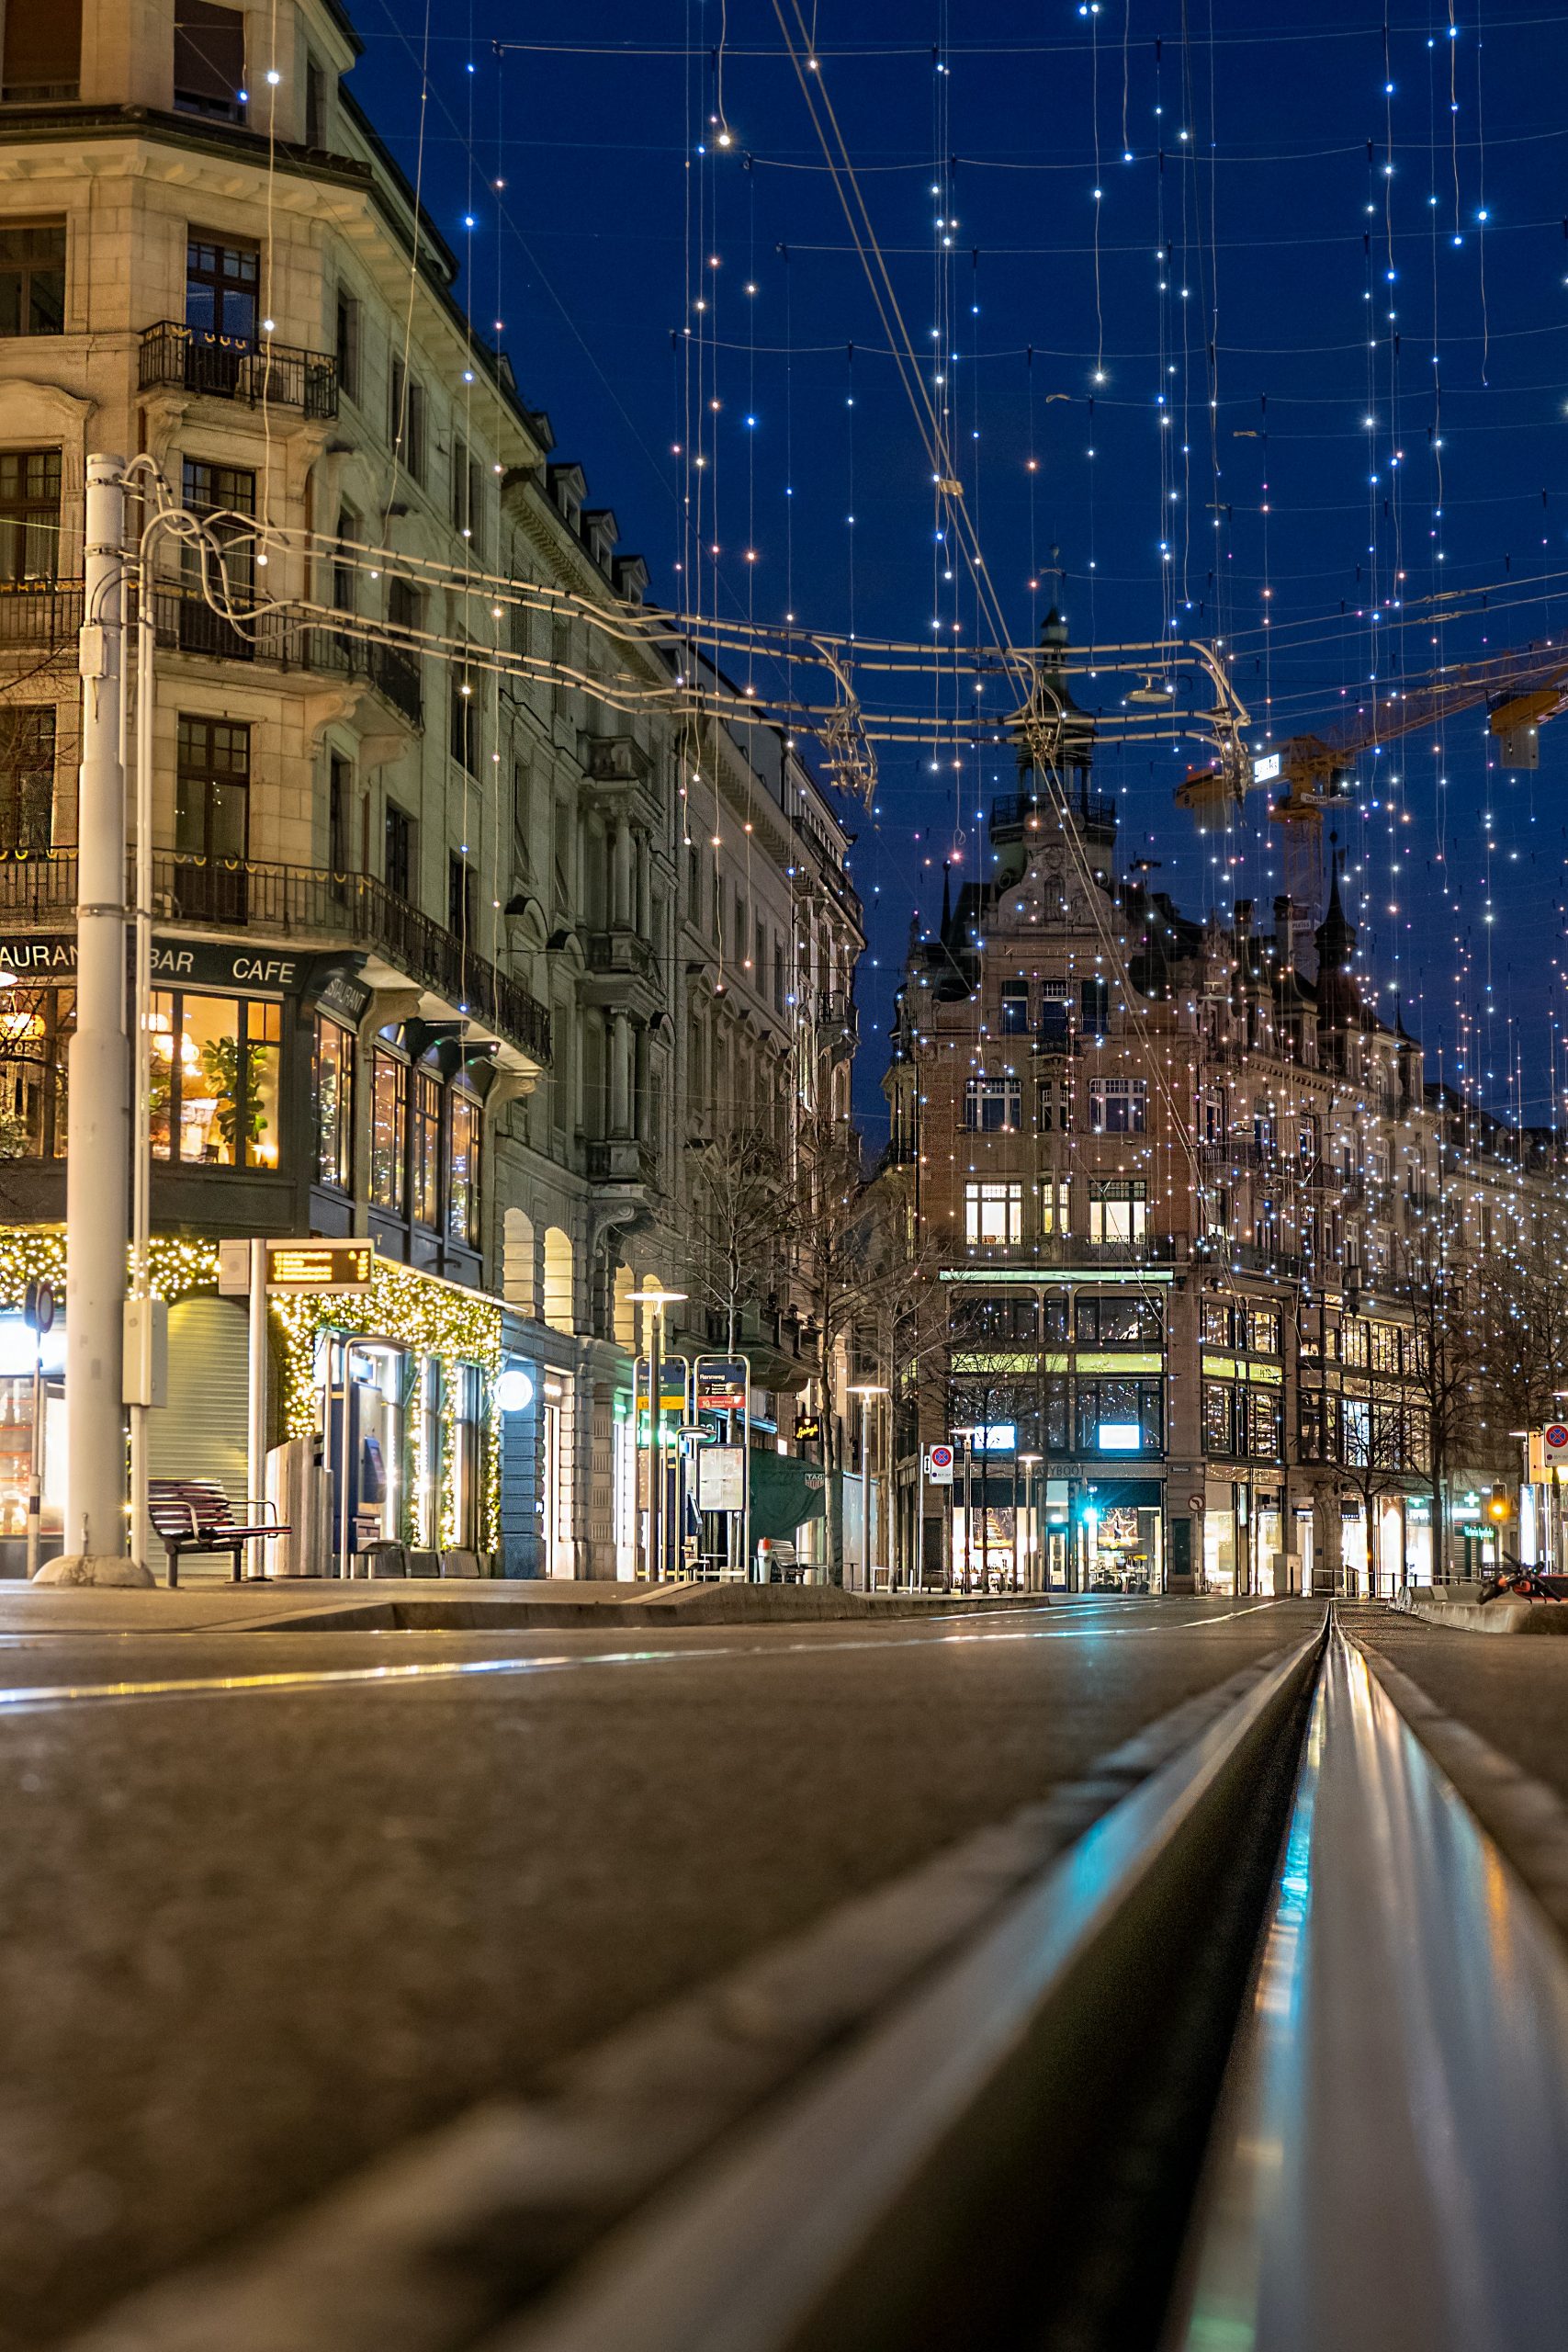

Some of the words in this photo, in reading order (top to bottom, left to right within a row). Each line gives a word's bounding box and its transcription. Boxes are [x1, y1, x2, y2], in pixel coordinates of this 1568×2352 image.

[150, 949, 194, 973] BAR
[232, 958, 296, 983] CAFE
[324, 978, 366, 1012] STAURANT
[705, 1386, 710, 1395] 7
[702, 1399, 711, 1408] 10
[807, 1473, 823, 1481] TAG
